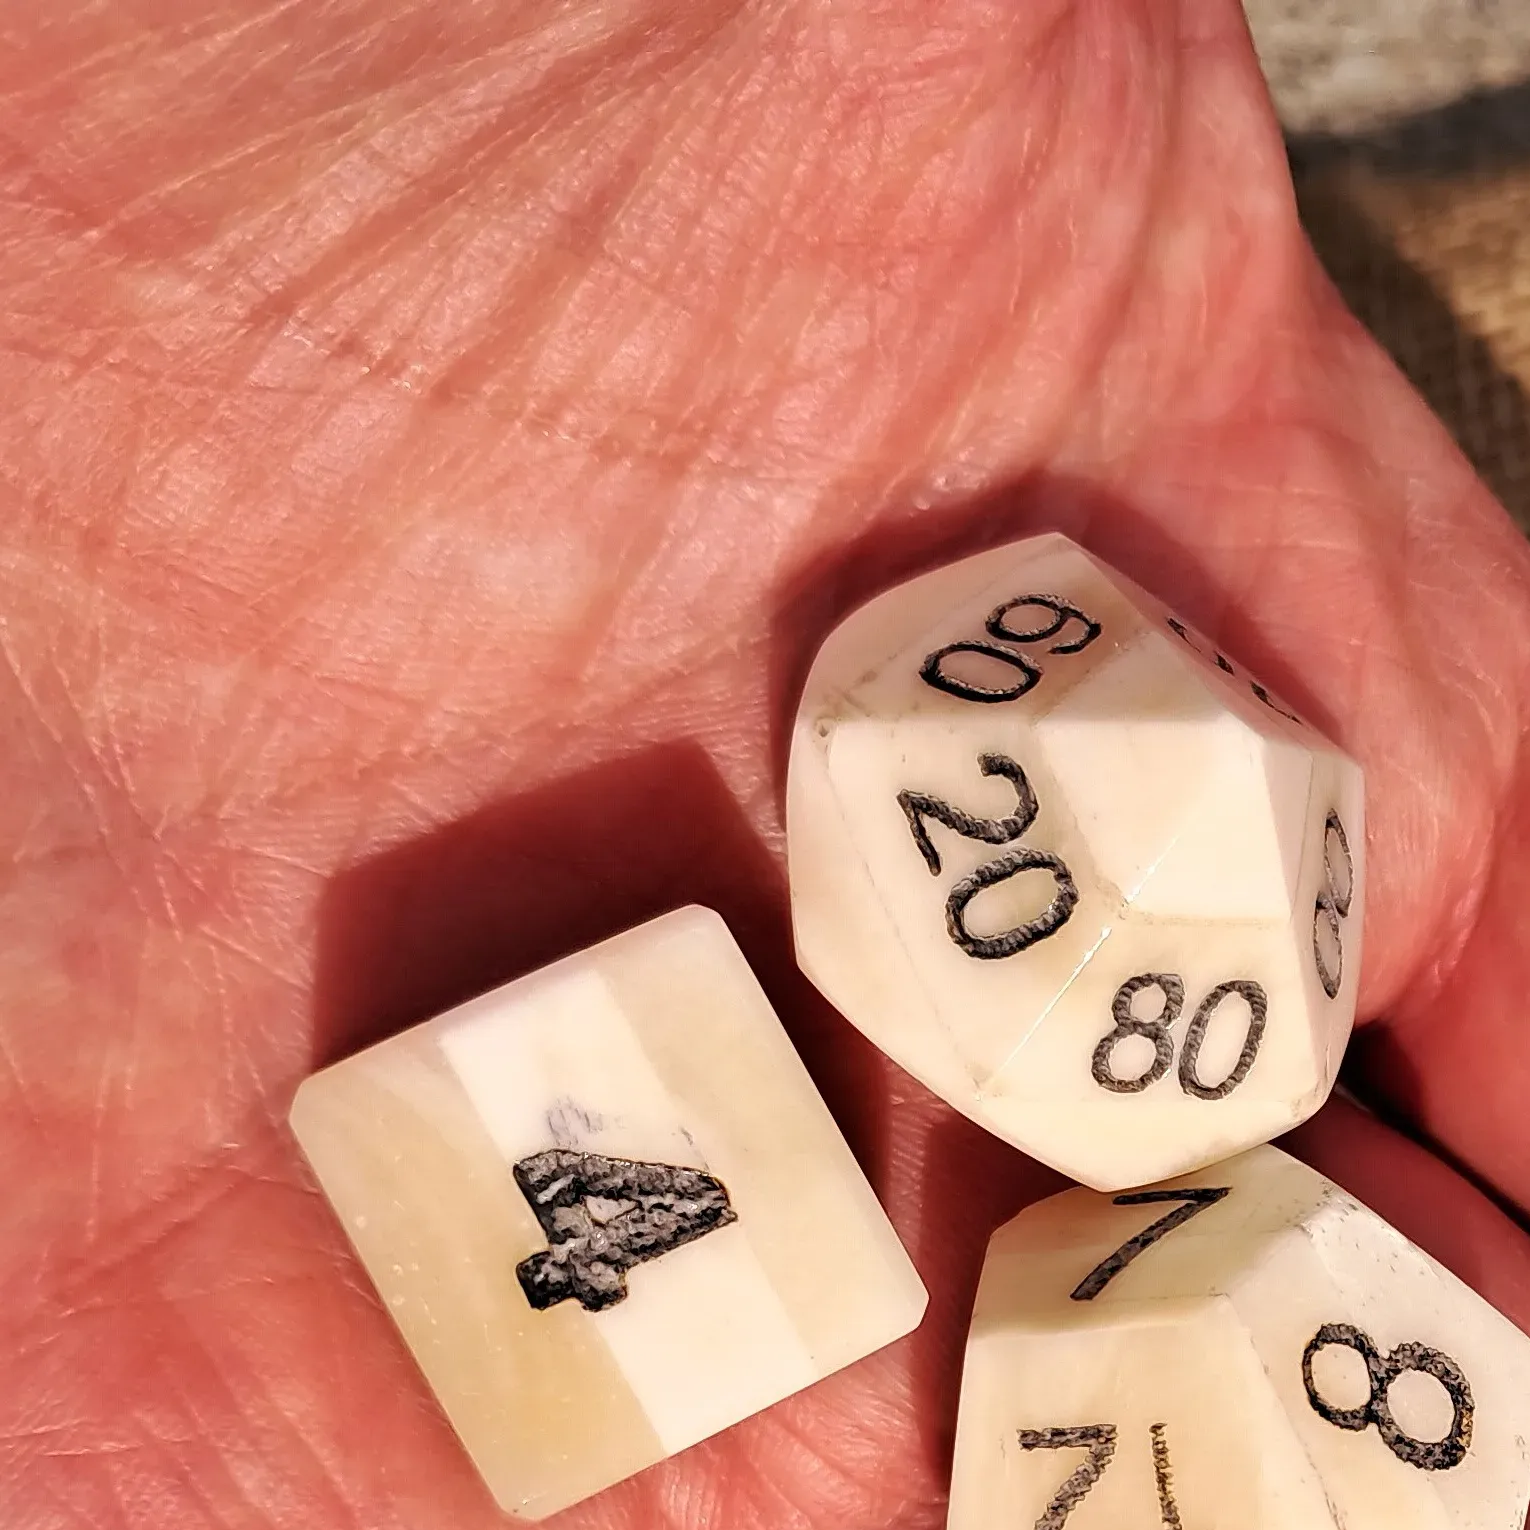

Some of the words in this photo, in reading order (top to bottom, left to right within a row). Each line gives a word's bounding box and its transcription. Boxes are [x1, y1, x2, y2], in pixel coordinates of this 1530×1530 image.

[896, 752, 1080, 960] 20
[1091, 973, 1268, 1100] 80
[513, 1147, 738, 1312] 4
[1069, 1186, 1231, 1300] 7
[1302, 1322, 1475, 1471] 8
